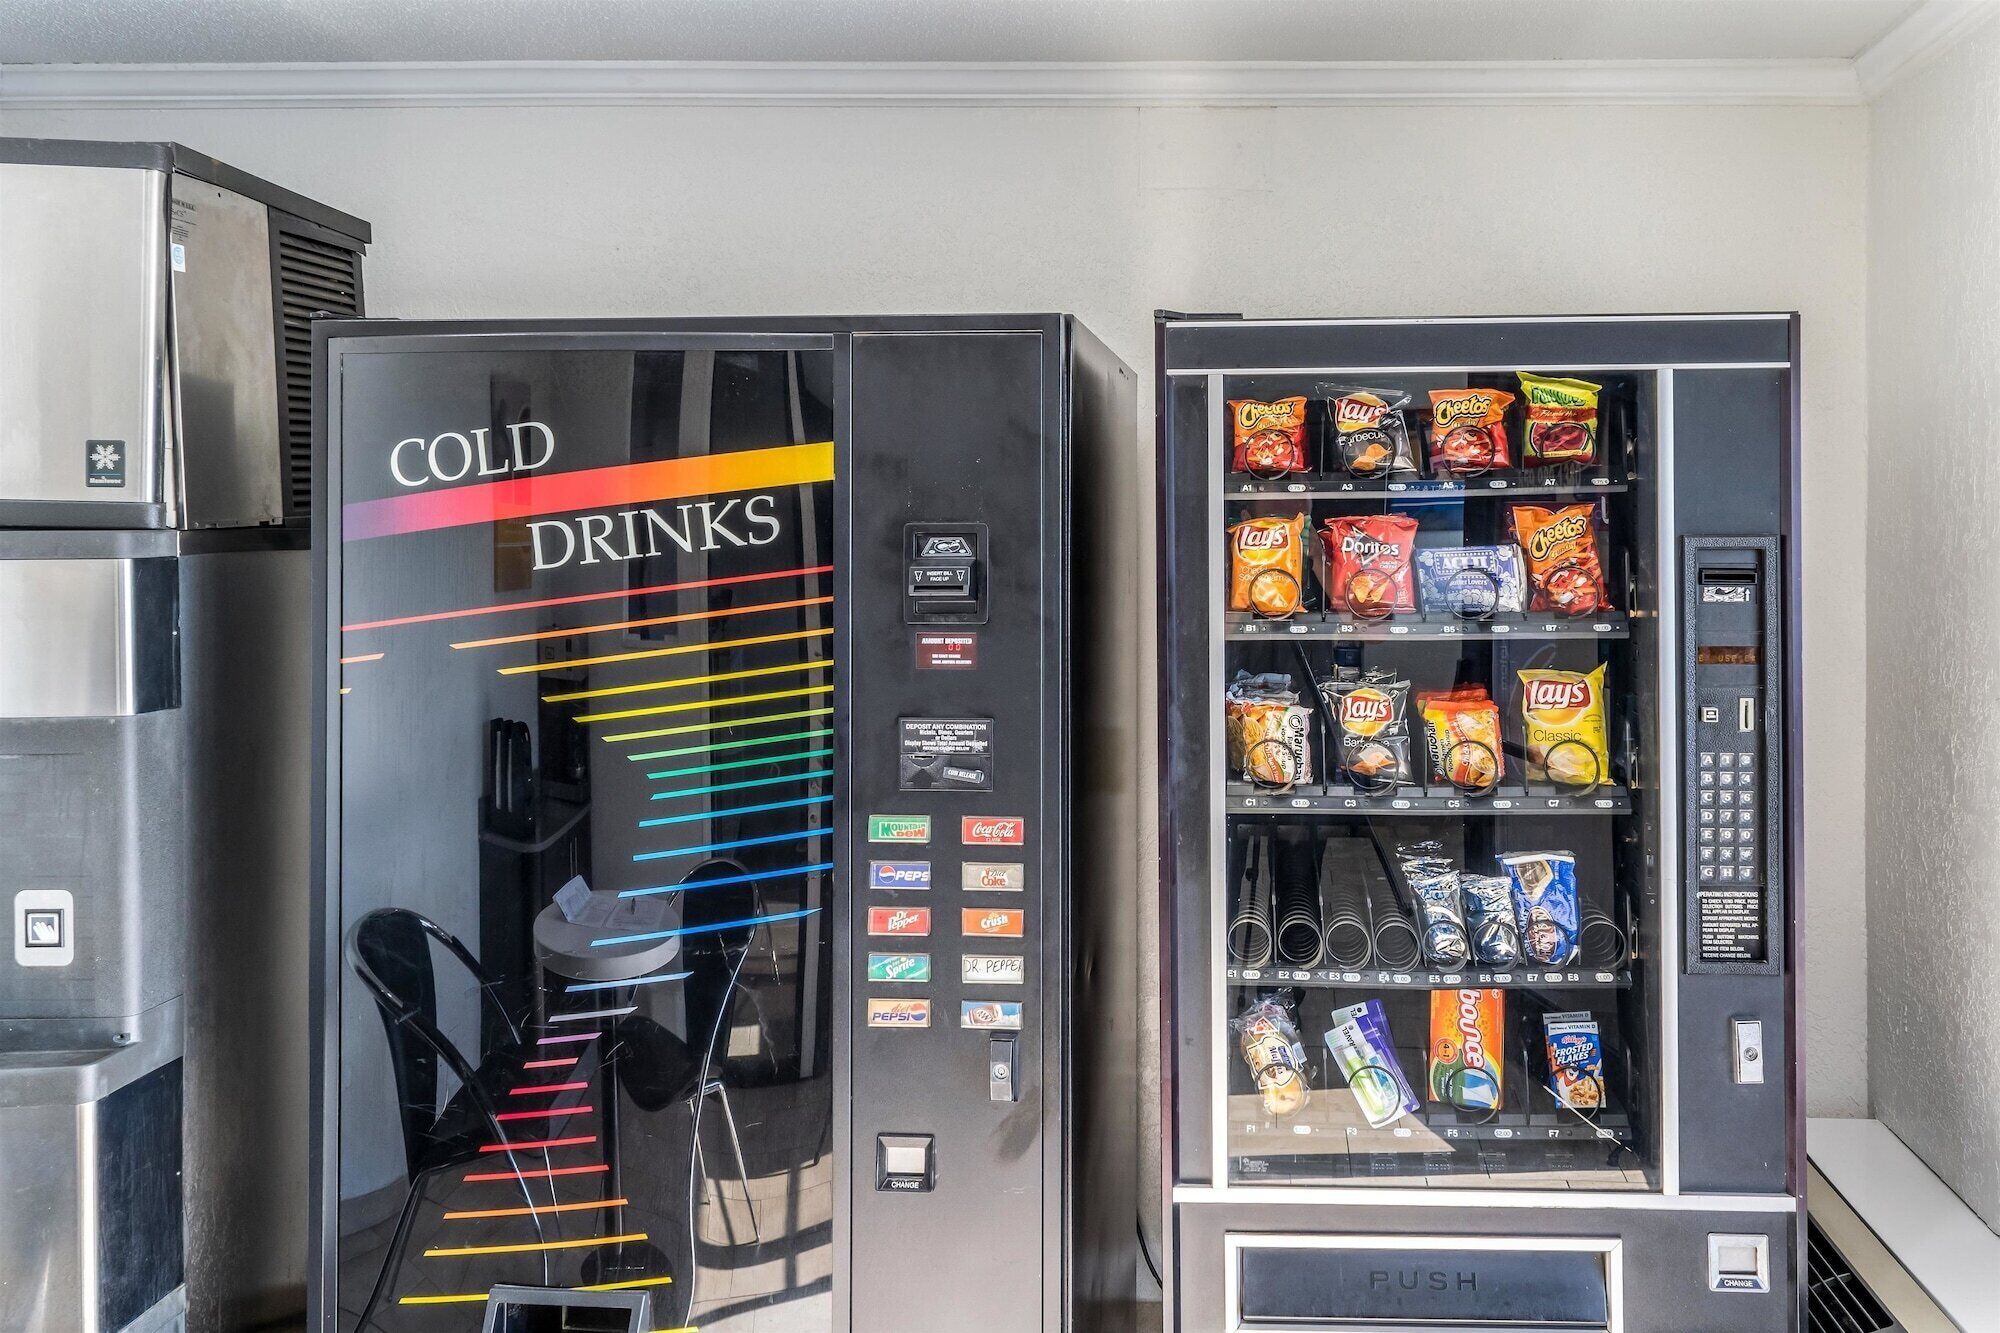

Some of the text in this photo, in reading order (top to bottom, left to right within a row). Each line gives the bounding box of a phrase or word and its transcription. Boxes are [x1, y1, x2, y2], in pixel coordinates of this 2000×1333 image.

[1240, 402, 1295, 428] Cheetos
[1435, 395, 1491, 427] Cheetos
[390, 421, 554, 487] COLD
[526, 496, 781, 571] DRINKS
[1530, 518, 1586, 561] Cheetos
[1342, 537, 1400, 555] Doritos
[1529, 680, 1584, 710] Lay's
[1346, 699, 1390, 722] Lay's
[1533, 729, 1582, 743] Classic
[1245, 798, 1256, 806] C1
[1345, 799, 1356, 807] C3
[1448, 800, 1460, 808] C5
[972, 822, 1017, 838] Coca-Cola
[895, 870, 929, 882] PEPS
[981, 875, 1006, 887] Coke
[888, 914, 919, 931] Pepper
[895, 910, 907, 920] Dr
[980, 914, 1009, 929] Crush
[885, 957, 916, 980] Sprite
[1279, 971, 1289, 979] E2
[1379, 974, 1389, 982] E4
[1429, 974, 1440, 982] E5
[1480, 974, 1491, 982] E6
[1568, 973, 1579, 981] E8
[872, 1011, 911, 1021] PEPSI
[1459, 990, 1484, 1069] bounce
[1555, 1043, 1593, 1059] FROSTED
[1556, 1052, 1589, 1066] FLAKES
[1347, 1127, 1357, 1135] F3
[1447, 1129, 1458, 1137] F5
[890, 1180, 920, 1190] CHANGE
[1370, 1271, 1478, 1291] PUSH
[1723, 1278, 1754, 1288] CHANGE
